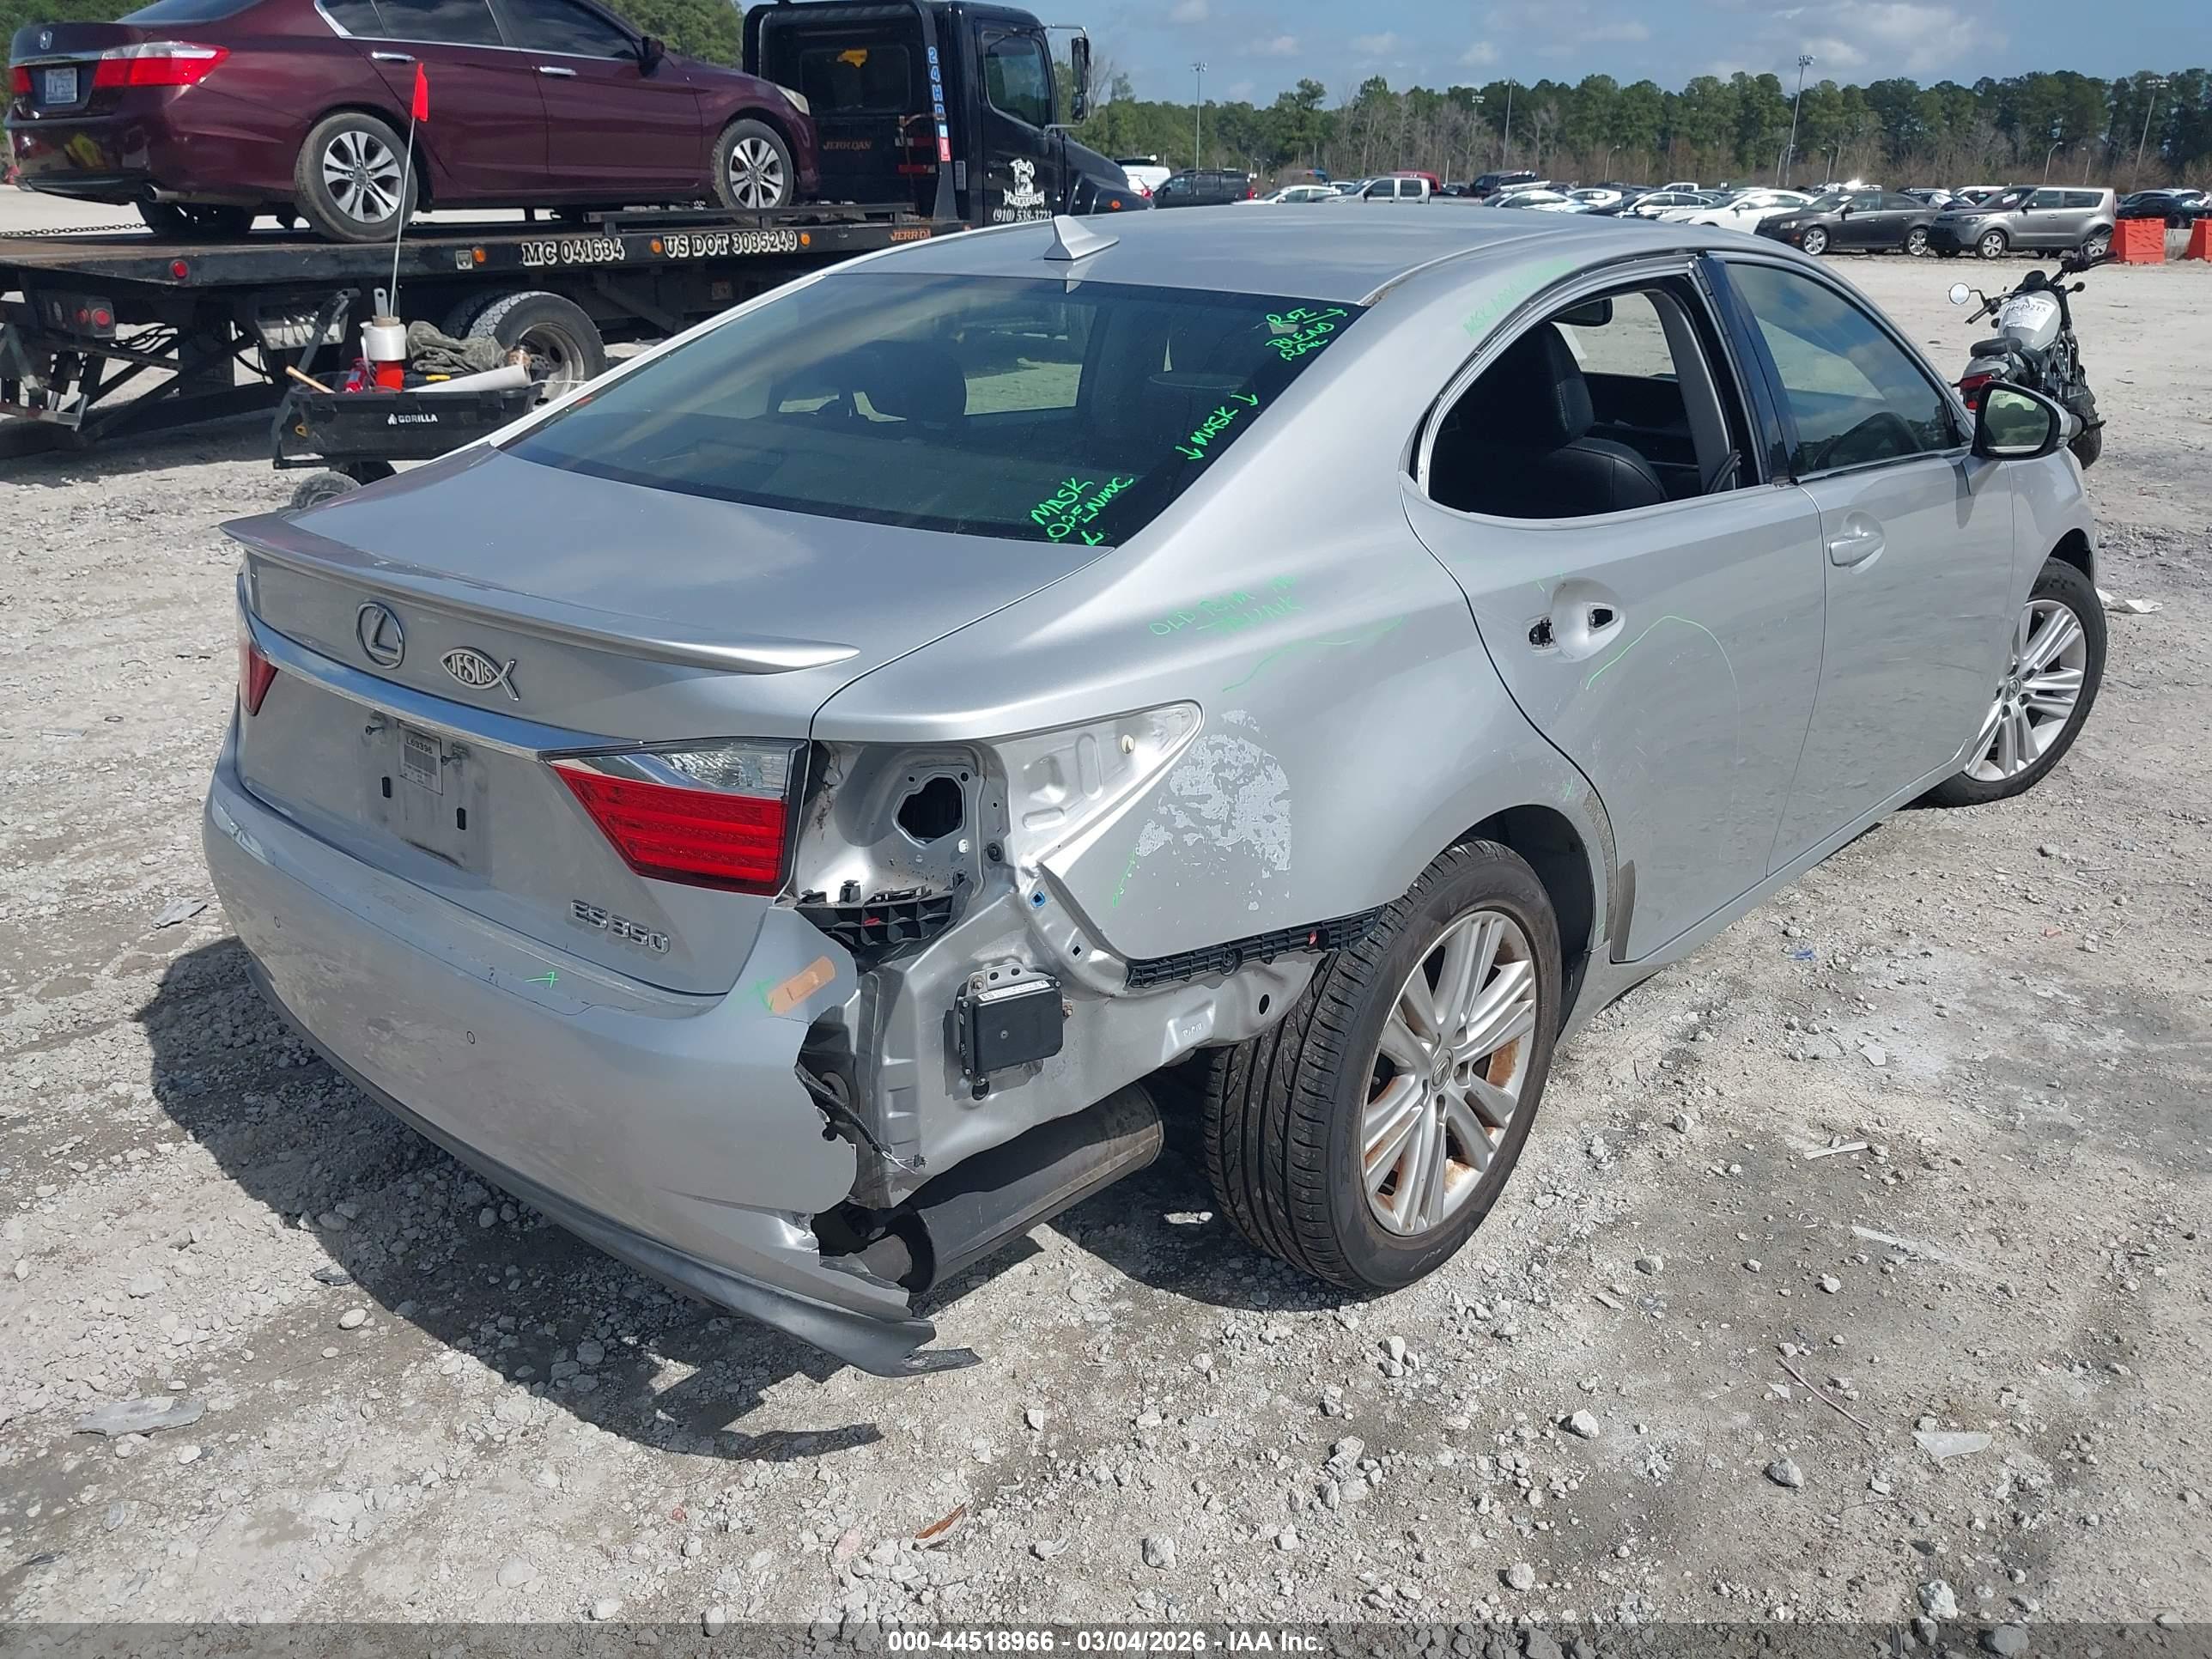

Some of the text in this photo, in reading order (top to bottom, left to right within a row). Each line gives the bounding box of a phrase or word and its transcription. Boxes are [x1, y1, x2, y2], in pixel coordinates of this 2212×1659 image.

[521, 237, 625, 266] MC 041634
[663, 230, 798, 258] US DOT 3035249
[398, 414, 438, 423] GORILLA
[1190, 406, 1238, 446] MASK
[1030, 477, 1095, 526] MASK
[447, 653, 492, 684] JESUS
[570, 900, 670, 955] ES 350
